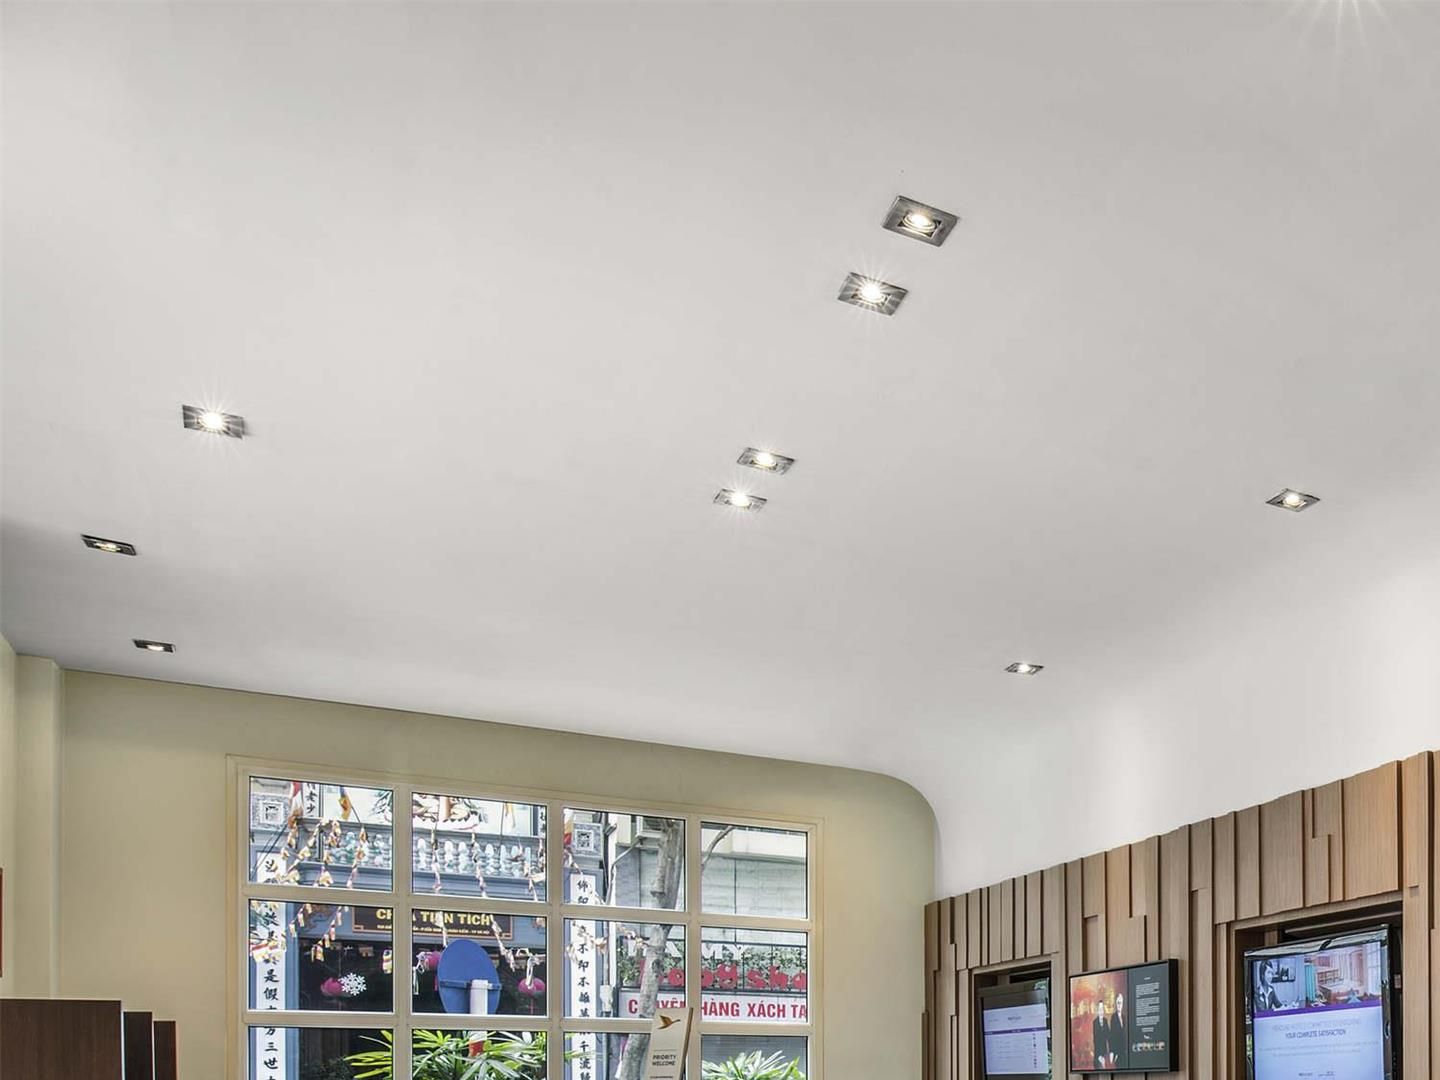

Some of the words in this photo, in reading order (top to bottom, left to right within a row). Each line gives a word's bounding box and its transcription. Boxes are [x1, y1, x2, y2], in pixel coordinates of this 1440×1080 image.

[420, 911, 454, 924] TIN
[701, 998, 740, 1018] HÀNG
[747, 1000, 786, 1019] XÁCH
